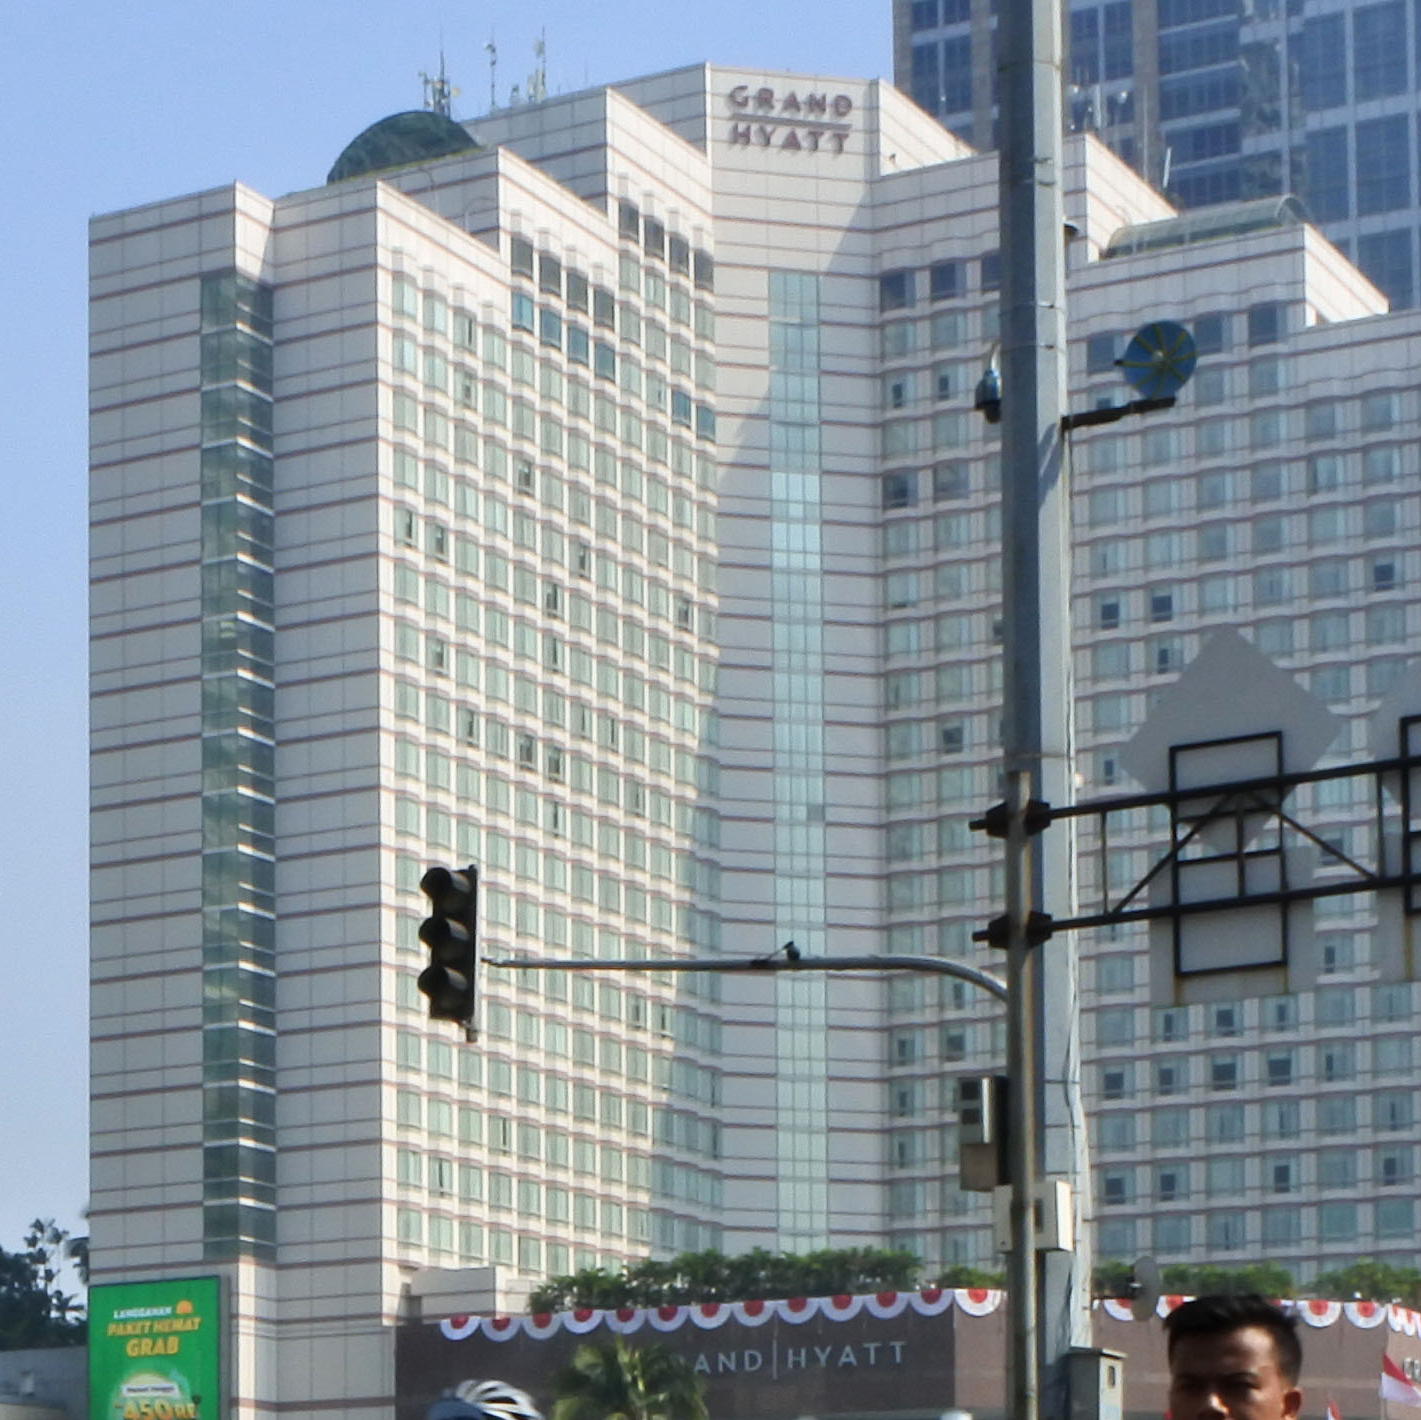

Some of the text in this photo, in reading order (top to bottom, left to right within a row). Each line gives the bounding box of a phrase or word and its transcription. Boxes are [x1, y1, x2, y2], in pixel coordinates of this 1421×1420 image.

[729, 85, 852, 117] GRAND
[730, 123, 850, 153] HYATT
[126, 1336, 179, 1357] GRAB
[787, 1341, 906, 1369] HYATT
